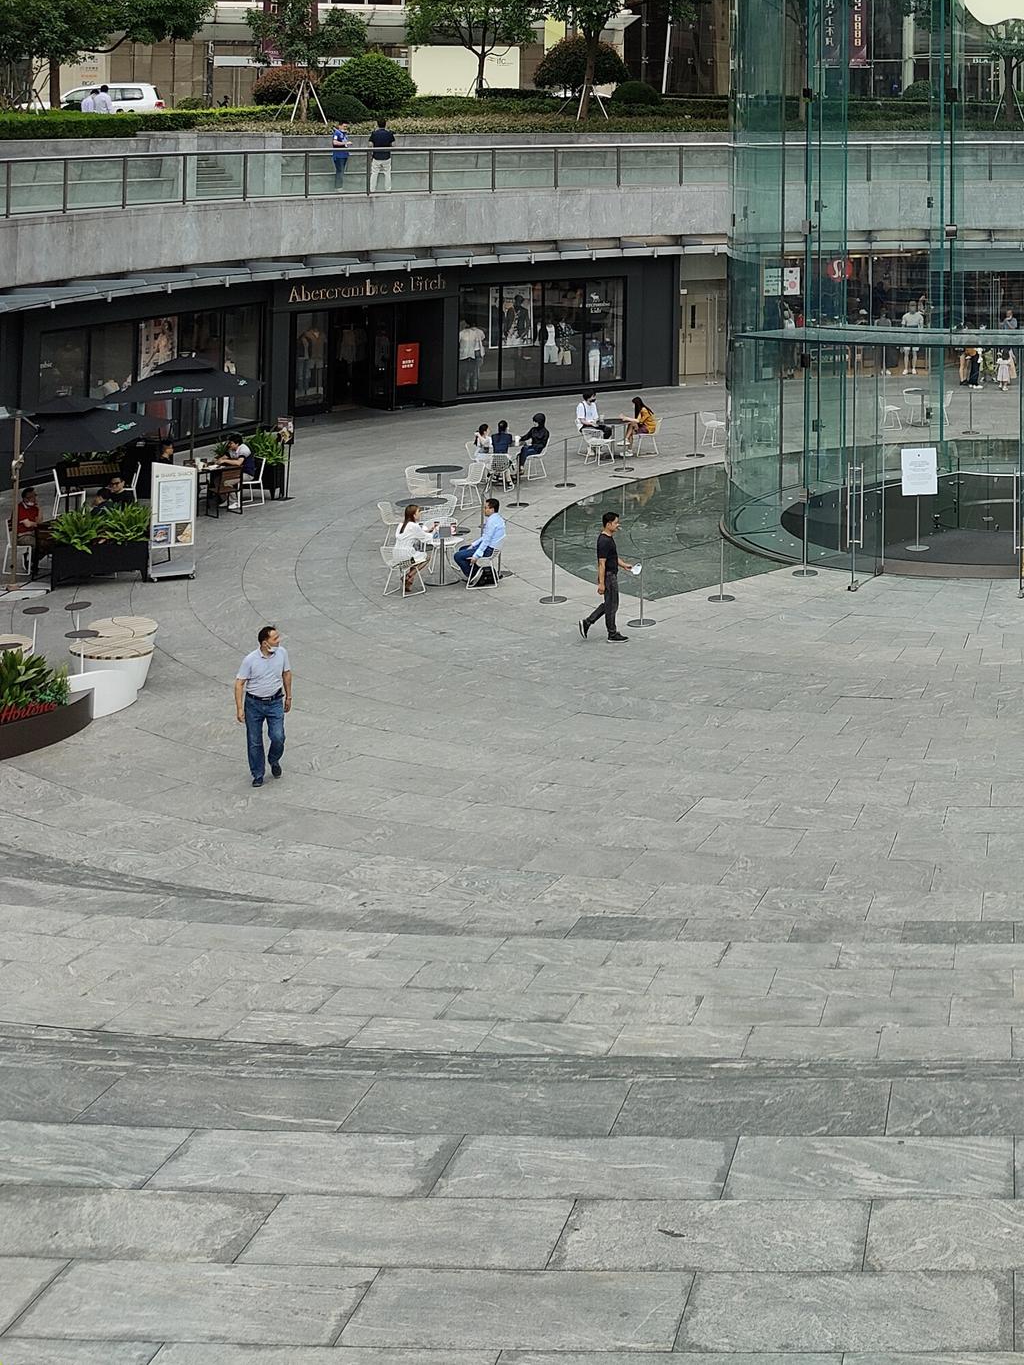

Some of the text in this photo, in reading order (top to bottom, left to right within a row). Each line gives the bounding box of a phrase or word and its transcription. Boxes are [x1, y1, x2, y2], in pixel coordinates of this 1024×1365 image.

[288, 273, 446, 302] Abercrombie & Fitch
